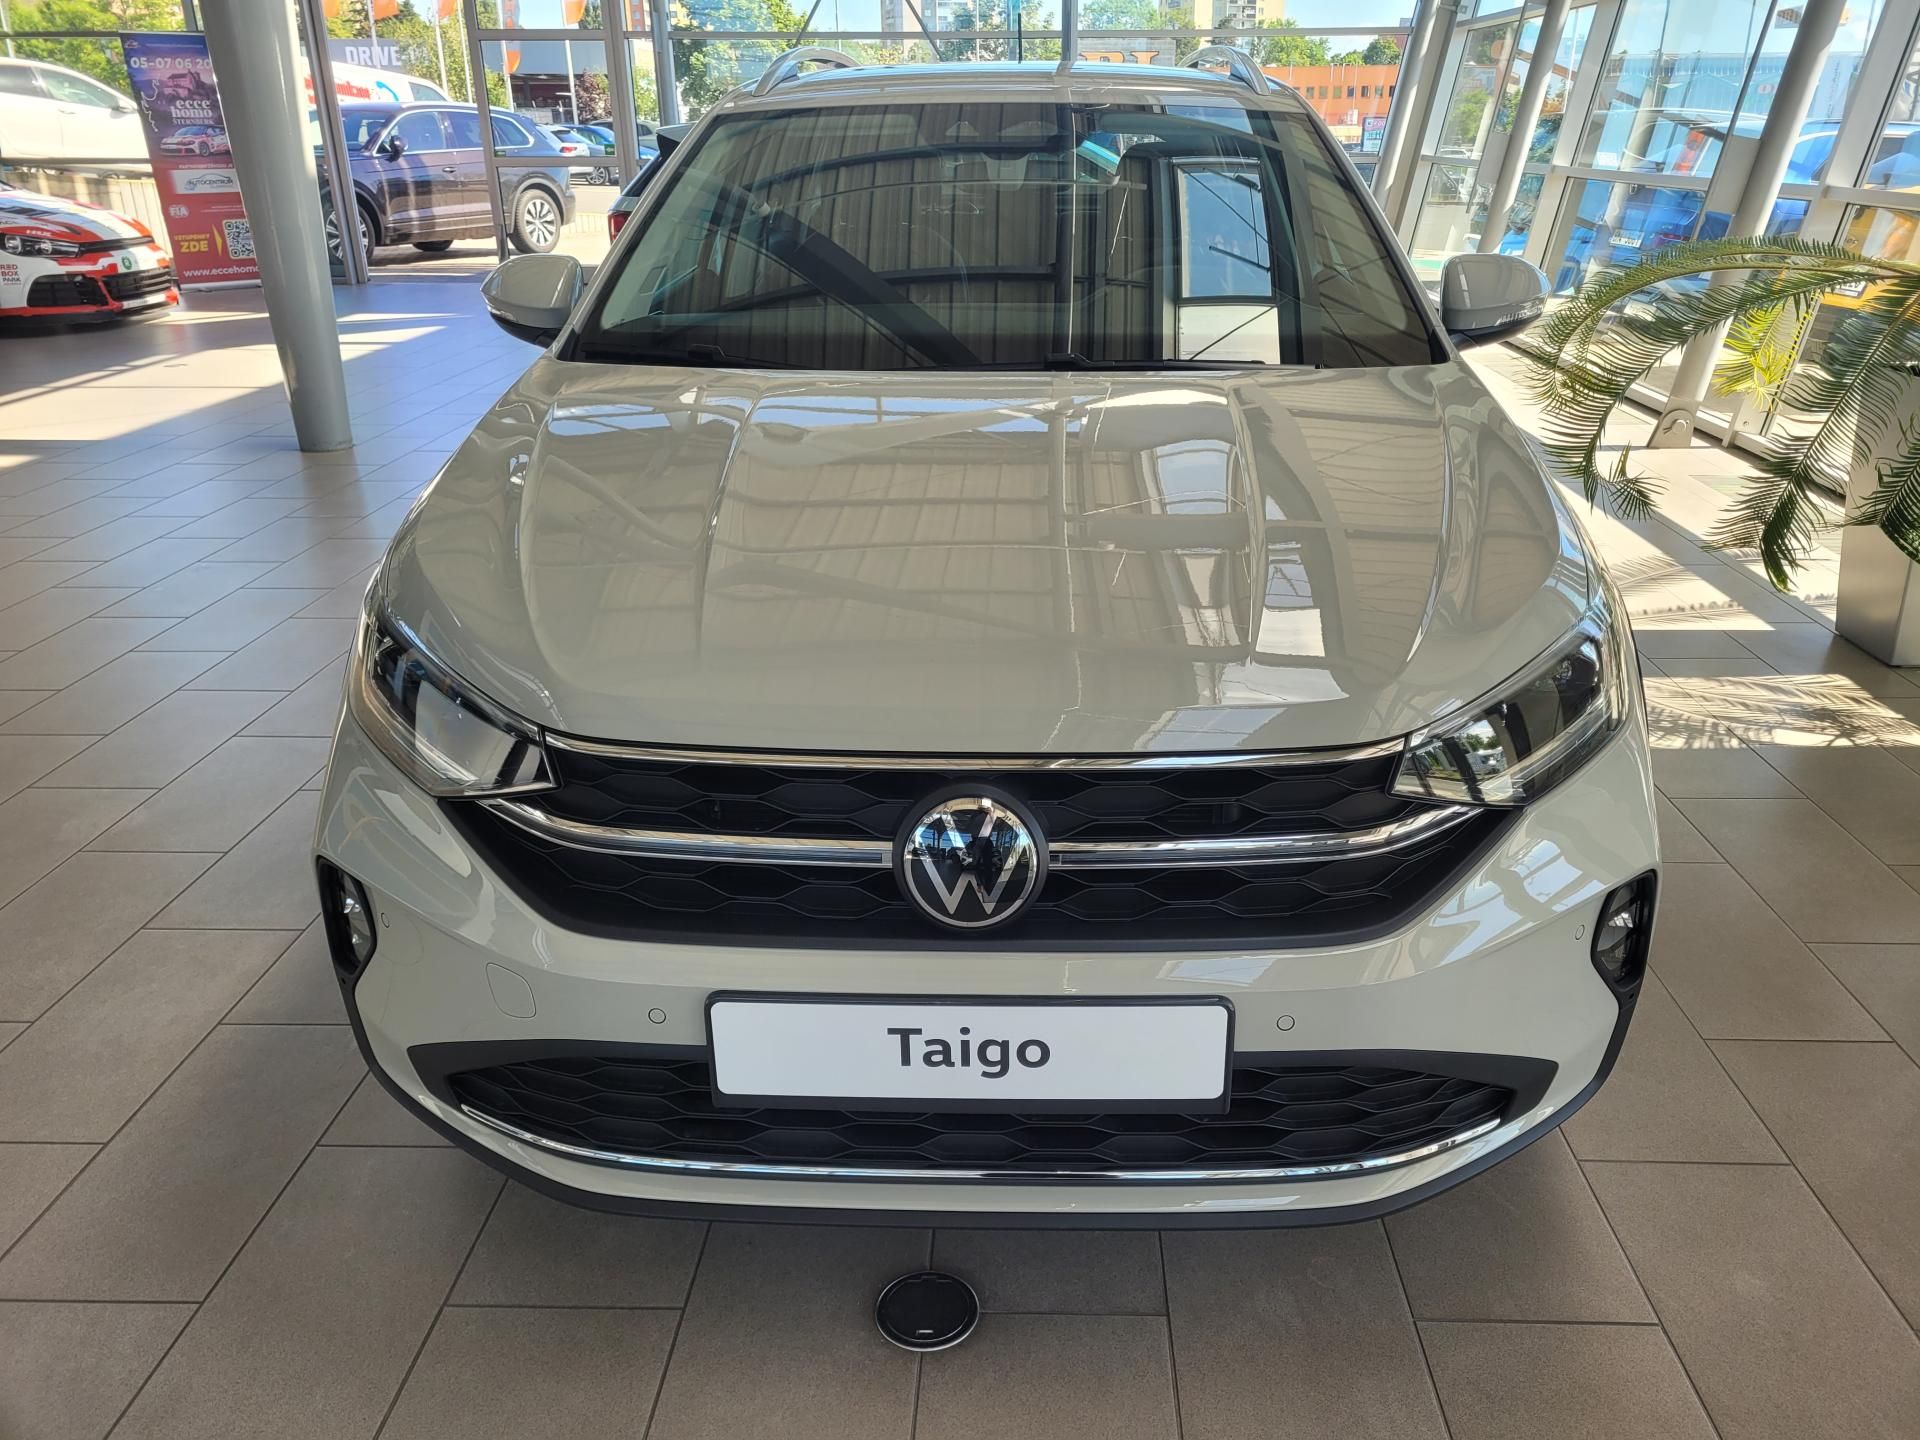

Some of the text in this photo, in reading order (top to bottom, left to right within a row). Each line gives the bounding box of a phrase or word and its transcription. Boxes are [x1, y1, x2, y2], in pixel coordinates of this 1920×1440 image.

[130, 57, 171, 68] 05-07
[175, 58, 192, 69] 06
[175, 99, 211, 109] ecce
[170, 106, 213, 118] homo
[169, 206, 189, 216] FIA
[180, 240, 209, 253] ZDE
[887, 1026, 1051, 1079] Taigo
